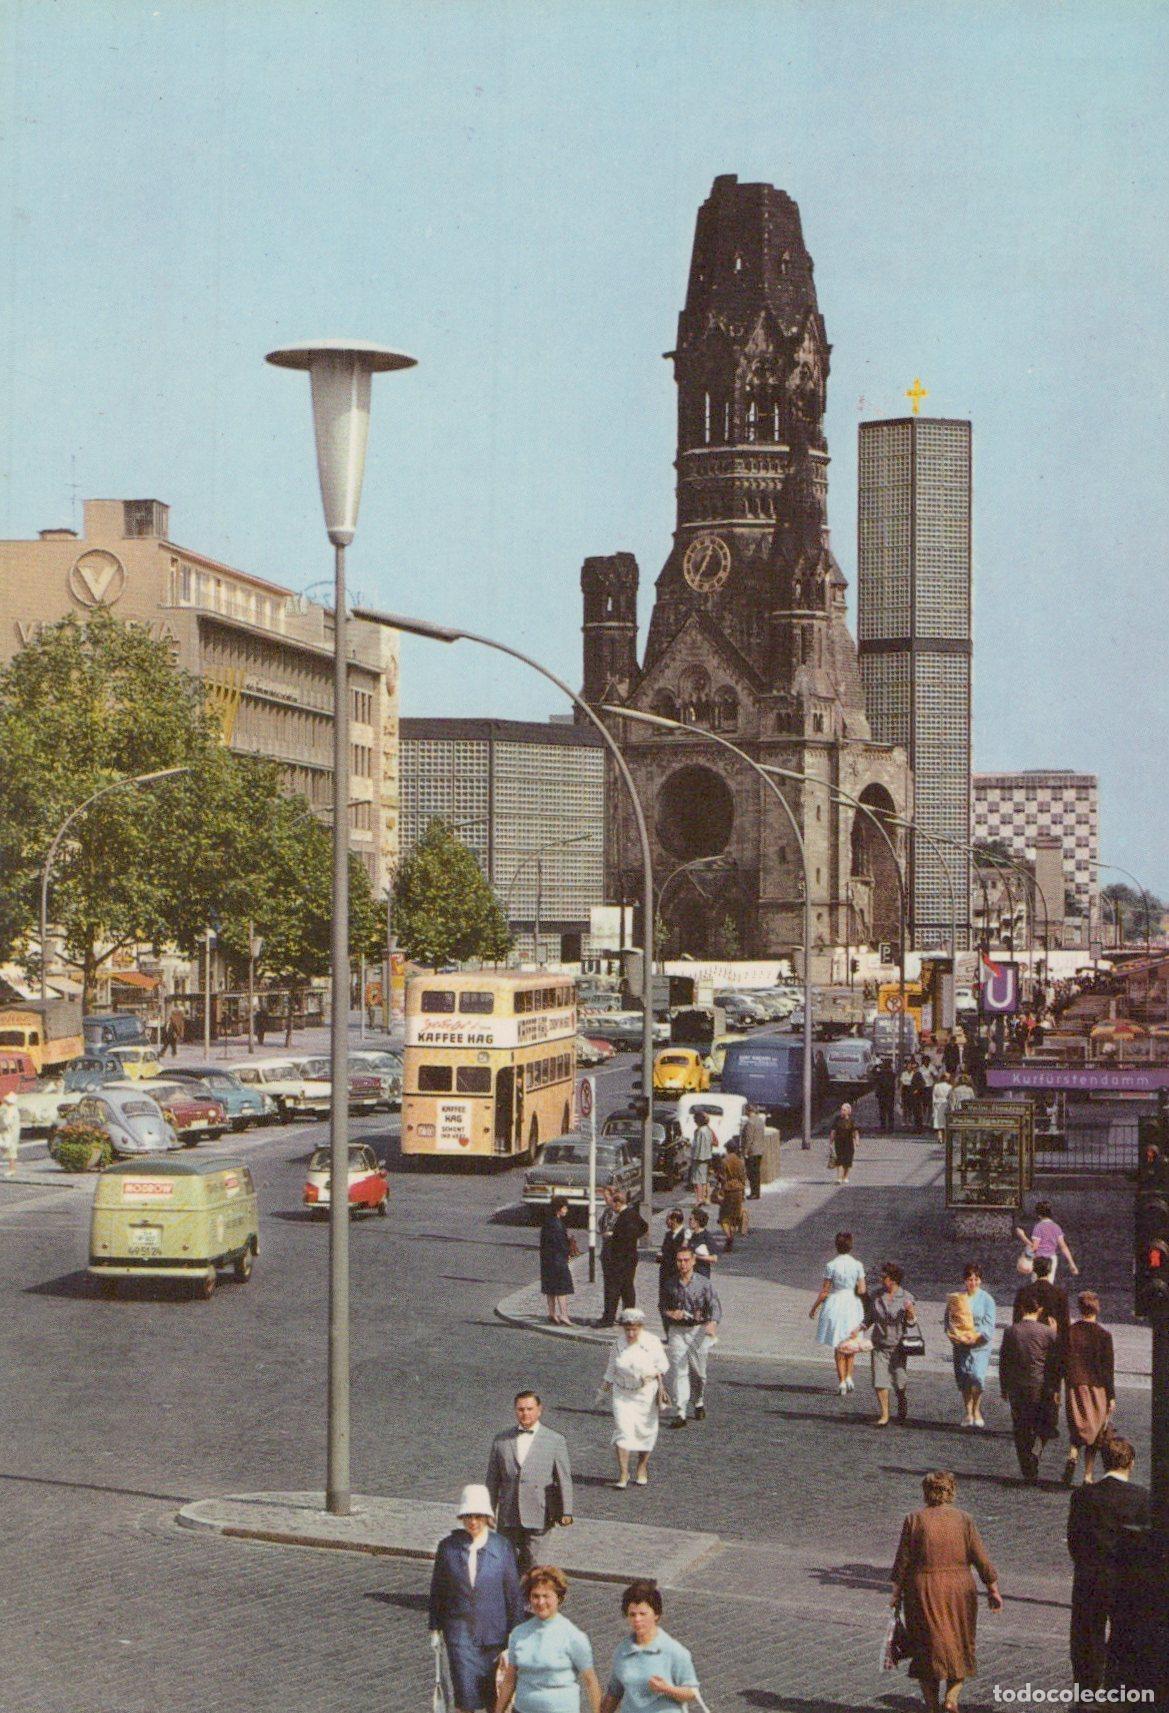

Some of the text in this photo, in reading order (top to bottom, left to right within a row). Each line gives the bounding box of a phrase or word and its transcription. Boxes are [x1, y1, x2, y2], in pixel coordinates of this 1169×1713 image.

[987, 969, 1013, 1008] U
[418, 1032, 494, 1044] KAFFEE HAG
[442, 1105, 466, 1113] KAFFEE
[445, 1114, 462, 1123] HAG
